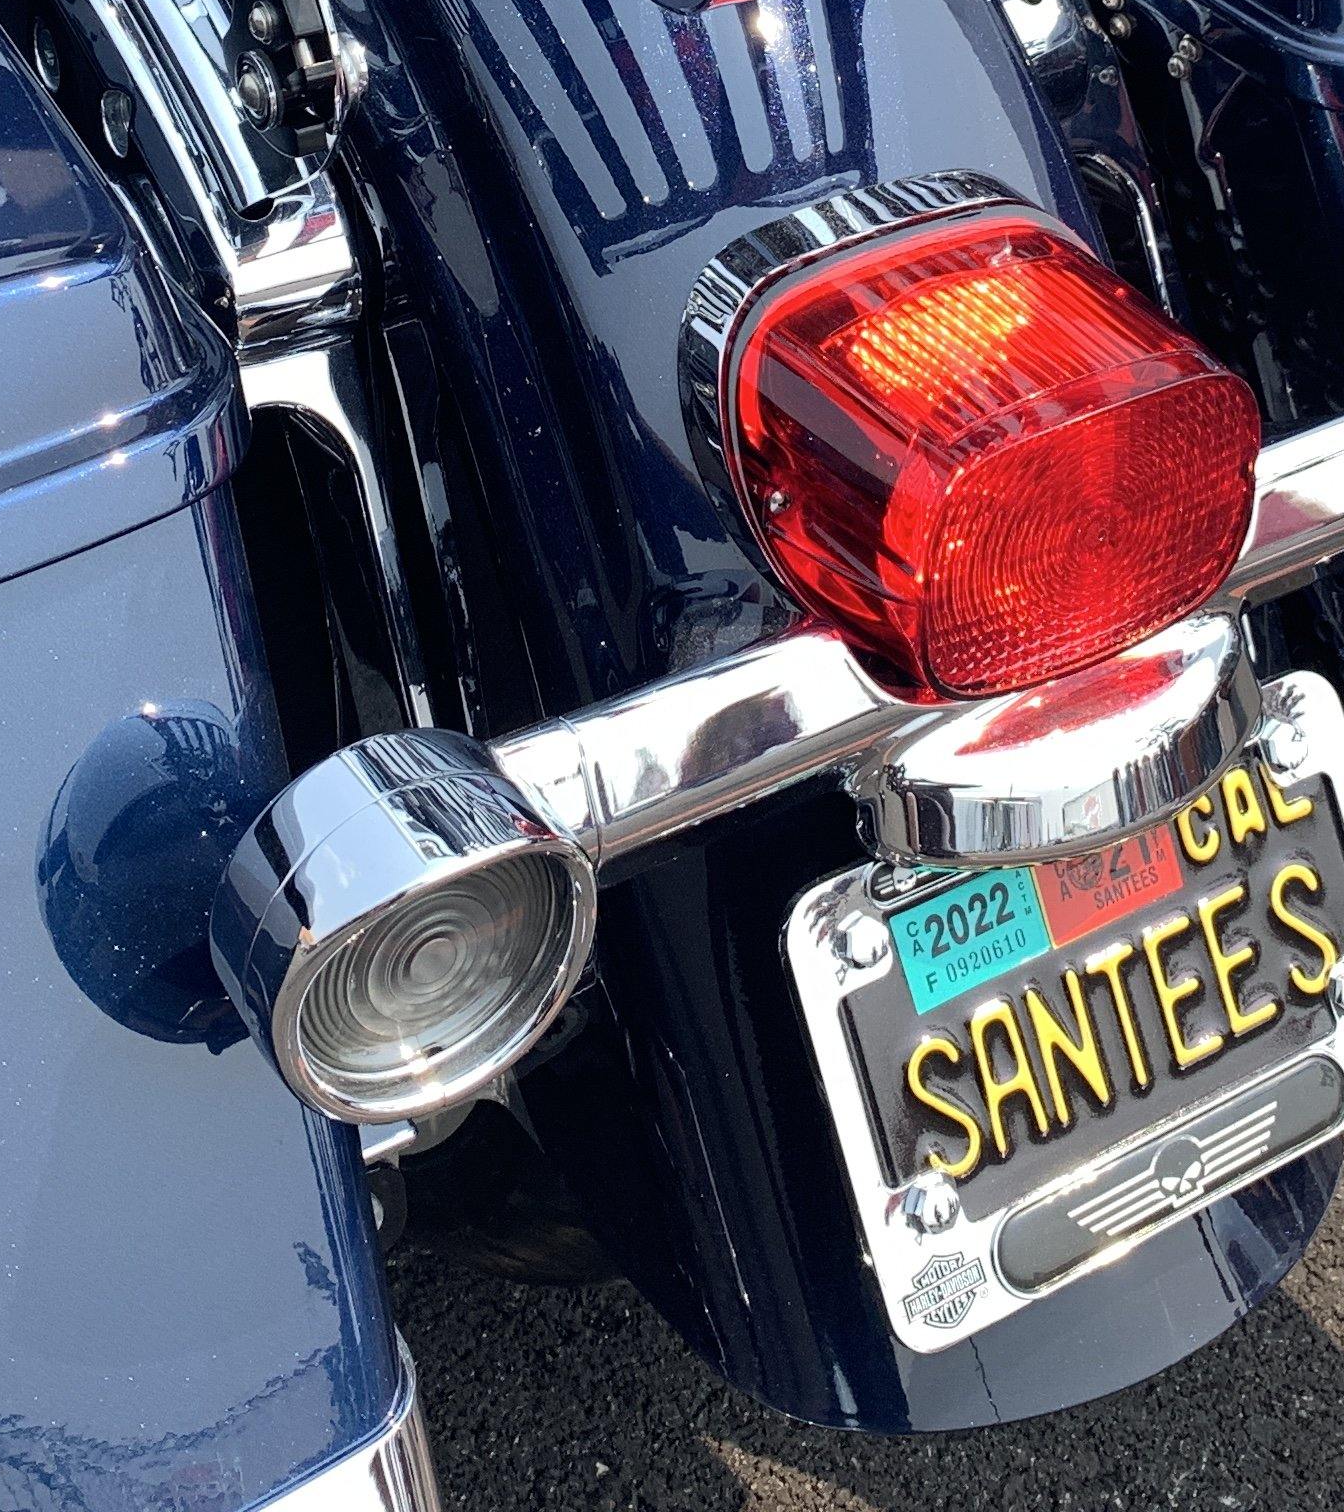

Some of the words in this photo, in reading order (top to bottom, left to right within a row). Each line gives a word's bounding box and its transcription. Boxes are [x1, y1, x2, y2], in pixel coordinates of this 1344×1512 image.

[1177, 762, 1315, 862] CAL
[1093, 865, 1159, 910] SANTEES
[924, 881, 1017, 959] 2022
[945, 928, 1028, 984] 0920610
[906, 862, 1339, 1180] SANTEES
[909, 1265, 980, 1316] HARLEY-DAVIDSON
[920, 1261, 958, 1288] MOTOR
[930, 1294, 968, 1322] CYCLES
